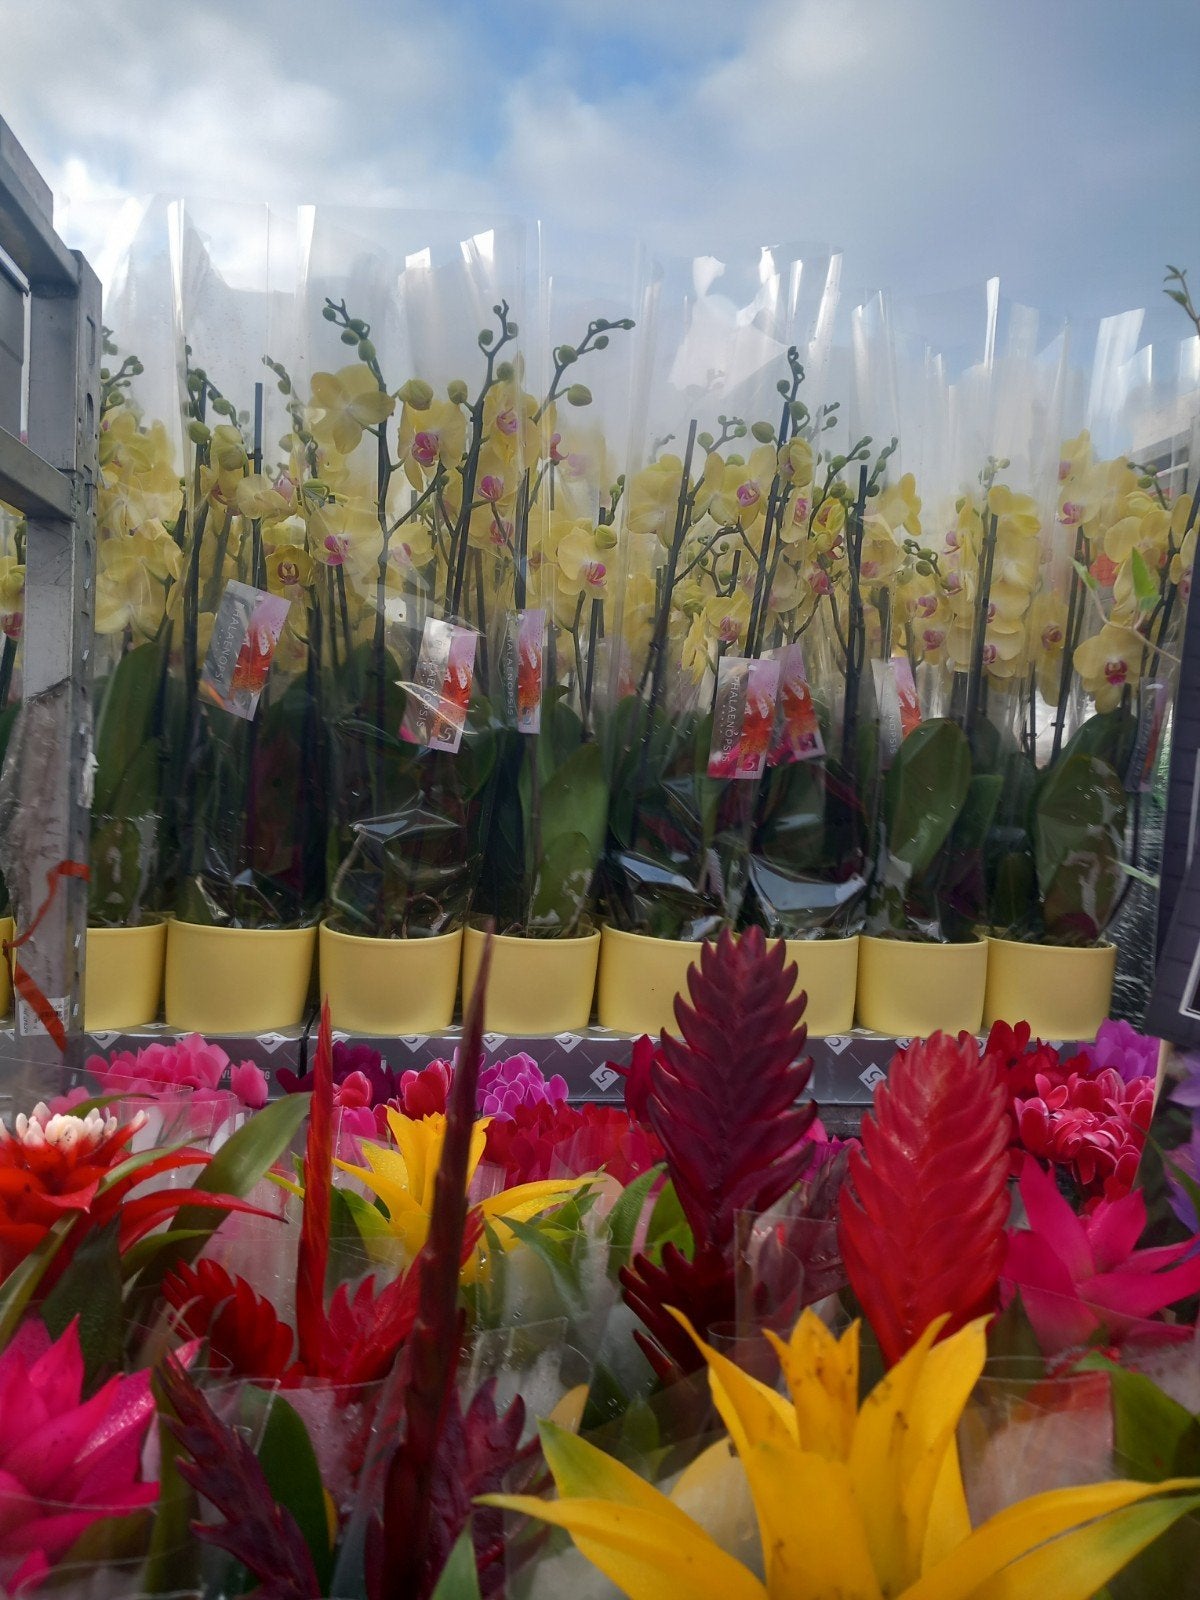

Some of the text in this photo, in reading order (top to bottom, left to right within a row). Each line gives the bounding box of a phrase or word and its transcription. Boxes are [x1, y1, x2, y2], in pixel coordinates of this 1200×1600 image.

[214, 603, 243, 685] HALAENOPSI
[503, 632, 515, 716] HALAENOPSIS
[721, 676, 740, 763] PHALAENOPSIS
